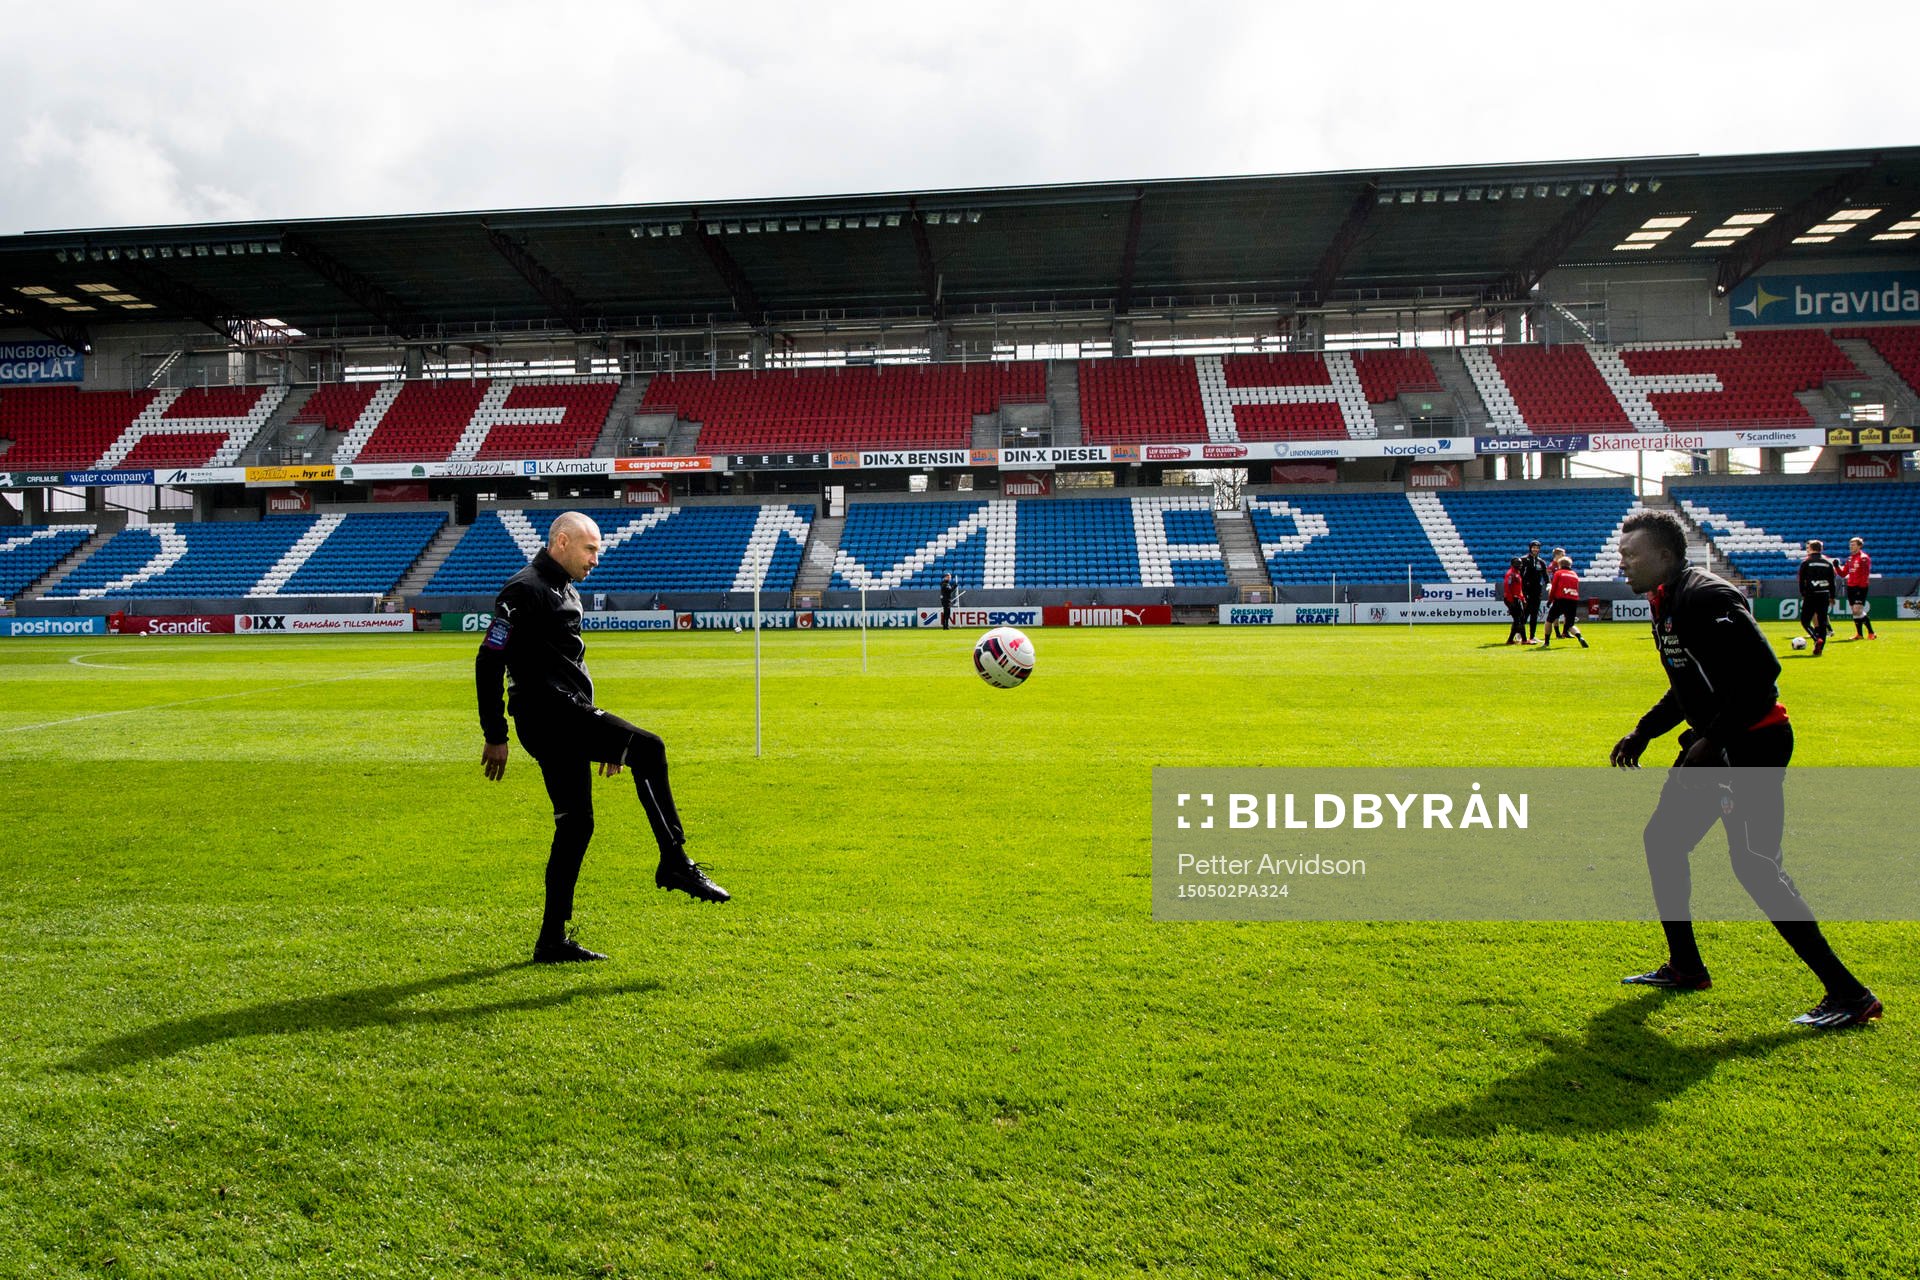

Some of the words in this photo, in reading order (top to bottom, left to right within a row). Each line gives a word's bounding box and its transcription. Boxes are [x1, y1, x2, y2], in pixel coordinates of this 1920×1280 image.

[1795, 281, 1920, 316] bravida
[0, 345, 76, 359] INGBORGS
[0, 358, 76, 379] GGPLÅT
[1592, 434, 1704, 450] Skånetrafiken
[1747, 432, 1796, 441] Scandlines
[1383, 444, 1437, 455] Nordea
[1481, 437, 1565, 450] LÖDDEPLÅT
[863, 454, 904, 466] DIN-X
[908, 452, 965, 465] BENSIN
[1004, 451, 1047, 463] DIN-X
[1052, 449, 1107, 461] DIESEL
[1289, 449, 1339, 457] LINDENGRUPPEN
[538, 463, 554, 473] LK
[556, 461, 608, 473] Armatur
[628, 459, 700, 471] cargorango.se
[1847, 465, 1887, 477] PUMA
[70, 474, 98, 482] water
[101, 472, 147, 484] company
[303, 469, 318, 480] hyr
[321, 469, 335, 478] ut!
[1412, 475, 1447, 487] PUMA
[1006, 484, 1039, 495] PUMA
[628, 492, 659, 503] PUMA
[271, 500, 301, 510] PUMA
[1422, 588, 1453, 600] borg
[1466, 588, 1496, 598] Hels
[1230, 607, 1273, 615] ÖRESUNDS
[1295, 607, 1339, 615] ÖRESUNDS
[1615, 604, 1649, 617] thor
[253, 615, 286, 630] IXX
[582, 615, 672, 630] Rörläggaren
[1069, 609, 1123, 626] PUMA
[1230, 614, 1274, 624] KRAFT
[1296, 614, 1339, 624] KRAFT
[11, 618, 93, 636] postnord
[149, 618, 210, 634] Scandic
